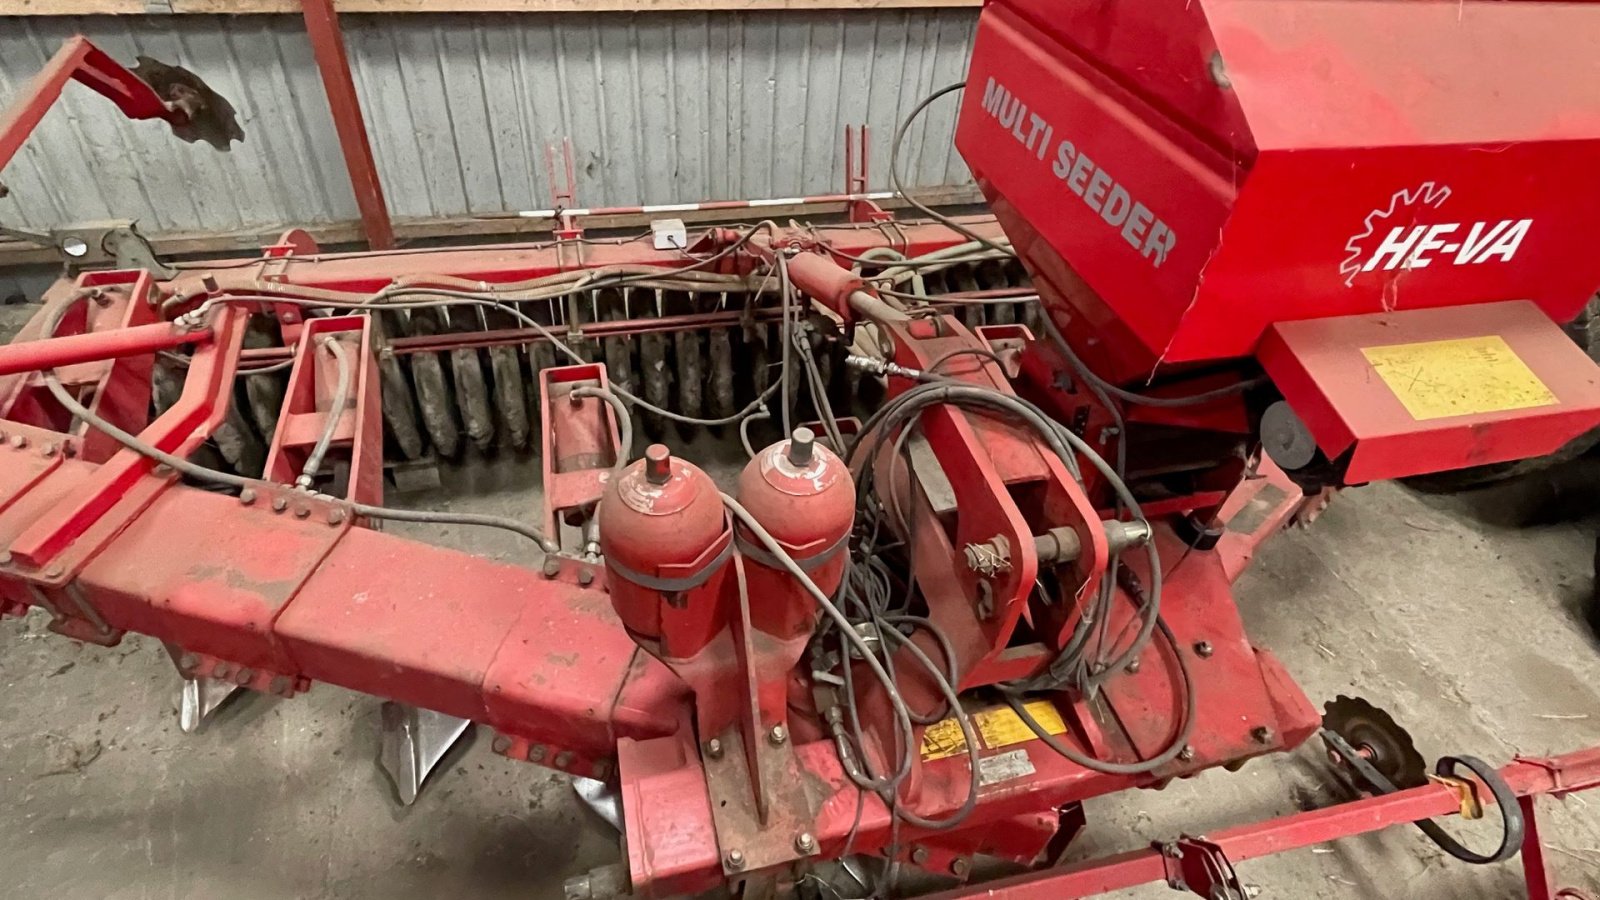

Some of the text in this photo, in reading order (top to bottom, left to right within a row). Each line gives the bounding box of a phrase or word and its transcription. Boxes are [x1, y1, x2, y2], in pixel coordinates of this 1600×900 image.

[981, 76, 1176, 268] MULTI SEEDER
[1360, 219, 1534, 272] HE-VA
